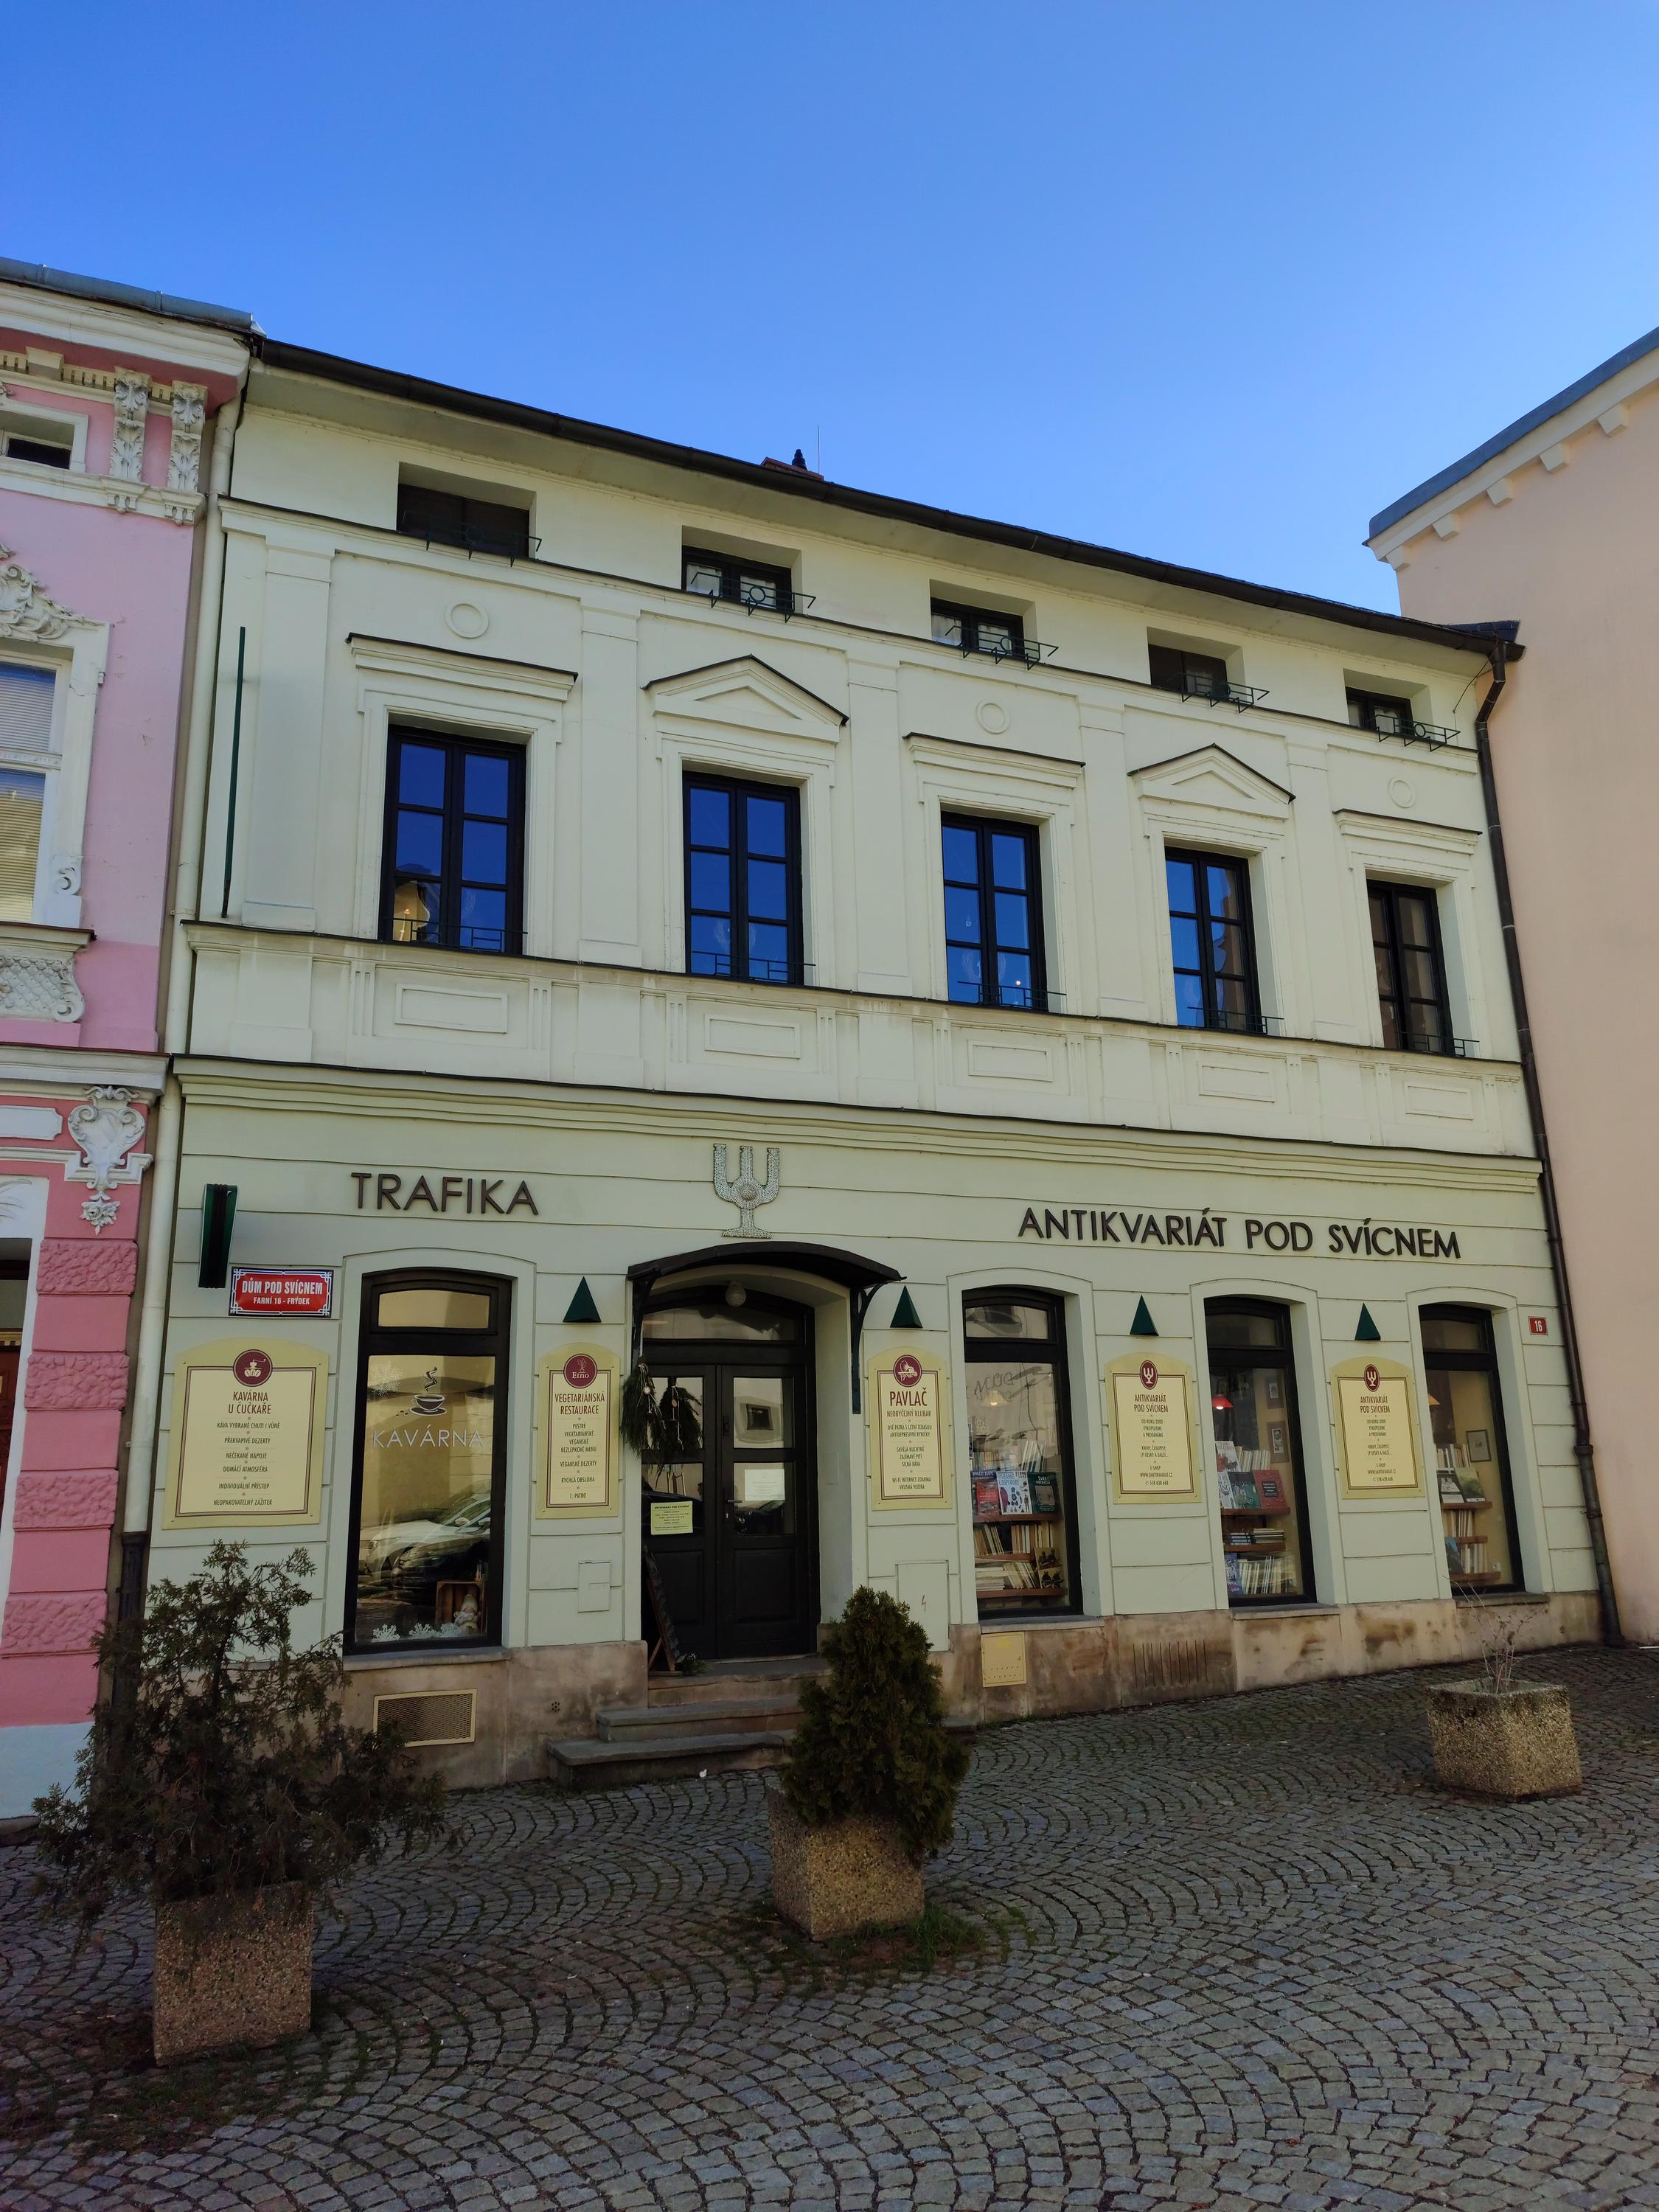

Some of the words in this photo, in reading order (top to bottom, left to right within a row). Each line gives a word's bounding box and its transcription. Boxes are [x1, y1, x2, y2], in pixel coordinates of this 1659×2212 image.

[351, 1172, 539, 1215] TRAFIKA
[1018, 1207, 1227, 1247] ANTIKVARIÁT
[1245, 1219, 1313, 1251] POD
[1329, 1218, 1461, 1259] SVÍCNEM
[242, 1277, 262, 1293] DŮM
[265, 1281, 282, 1294] POD
[284, 1279, 322, 1295] SVÍCNEM
[254, 1296, 272, 1304] FARNÍ
[288, 1296, 310, 1305] FRÝDEK
[1534, 1320, 1543, 1332] 16
[233, 1390, 268, 1401] KAVÁRNA
[555, 1391, 605, 1402] VEGETARIÁNSKÁ
[890, 1387, 928, 1406] PAVLAČ
[1135, 1393, 1166, 1402] ANTIKVARIÁT
[229, 1404, 234, 1413] U
[237, 1402, 271, 1414] ČUČKAŘE
[560, 1405, 599, 1414] RESTAURACE
[887, 1409, 914, 1417] NEOBYČEJNÝ
[1147, 1403, 1168, 1413] SVÍCNEM
[372, 1425, 483, 1448] KAVÁRNA
